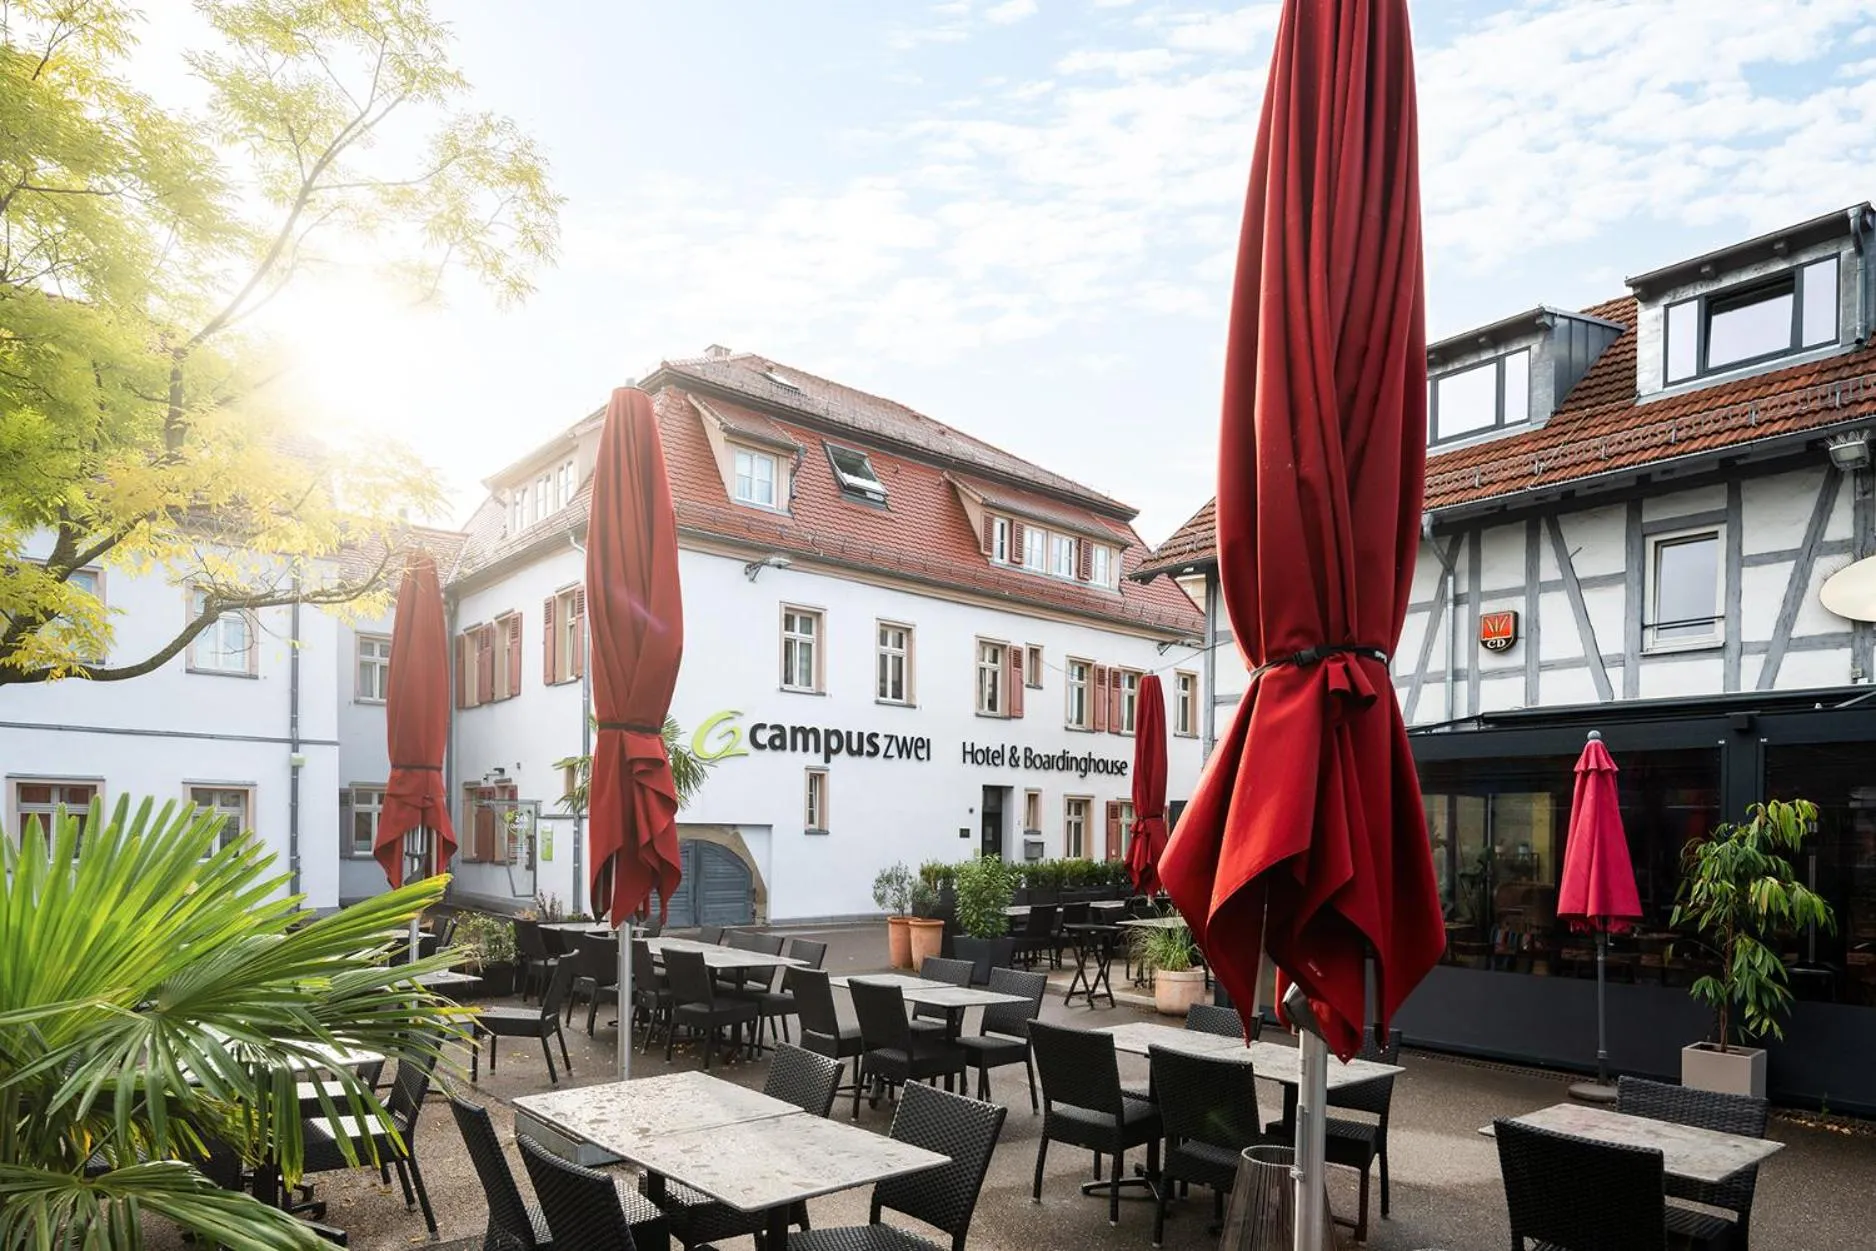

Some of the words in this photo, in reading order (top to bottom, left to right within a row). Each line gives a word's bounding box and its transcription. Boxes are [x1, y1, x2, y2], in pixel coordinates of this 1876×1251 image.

[962, 741, 1005, 767] Hotel
[1008, 745, 1021, 769] &
[1023, 746, 1129, 778] Boardinghouse
